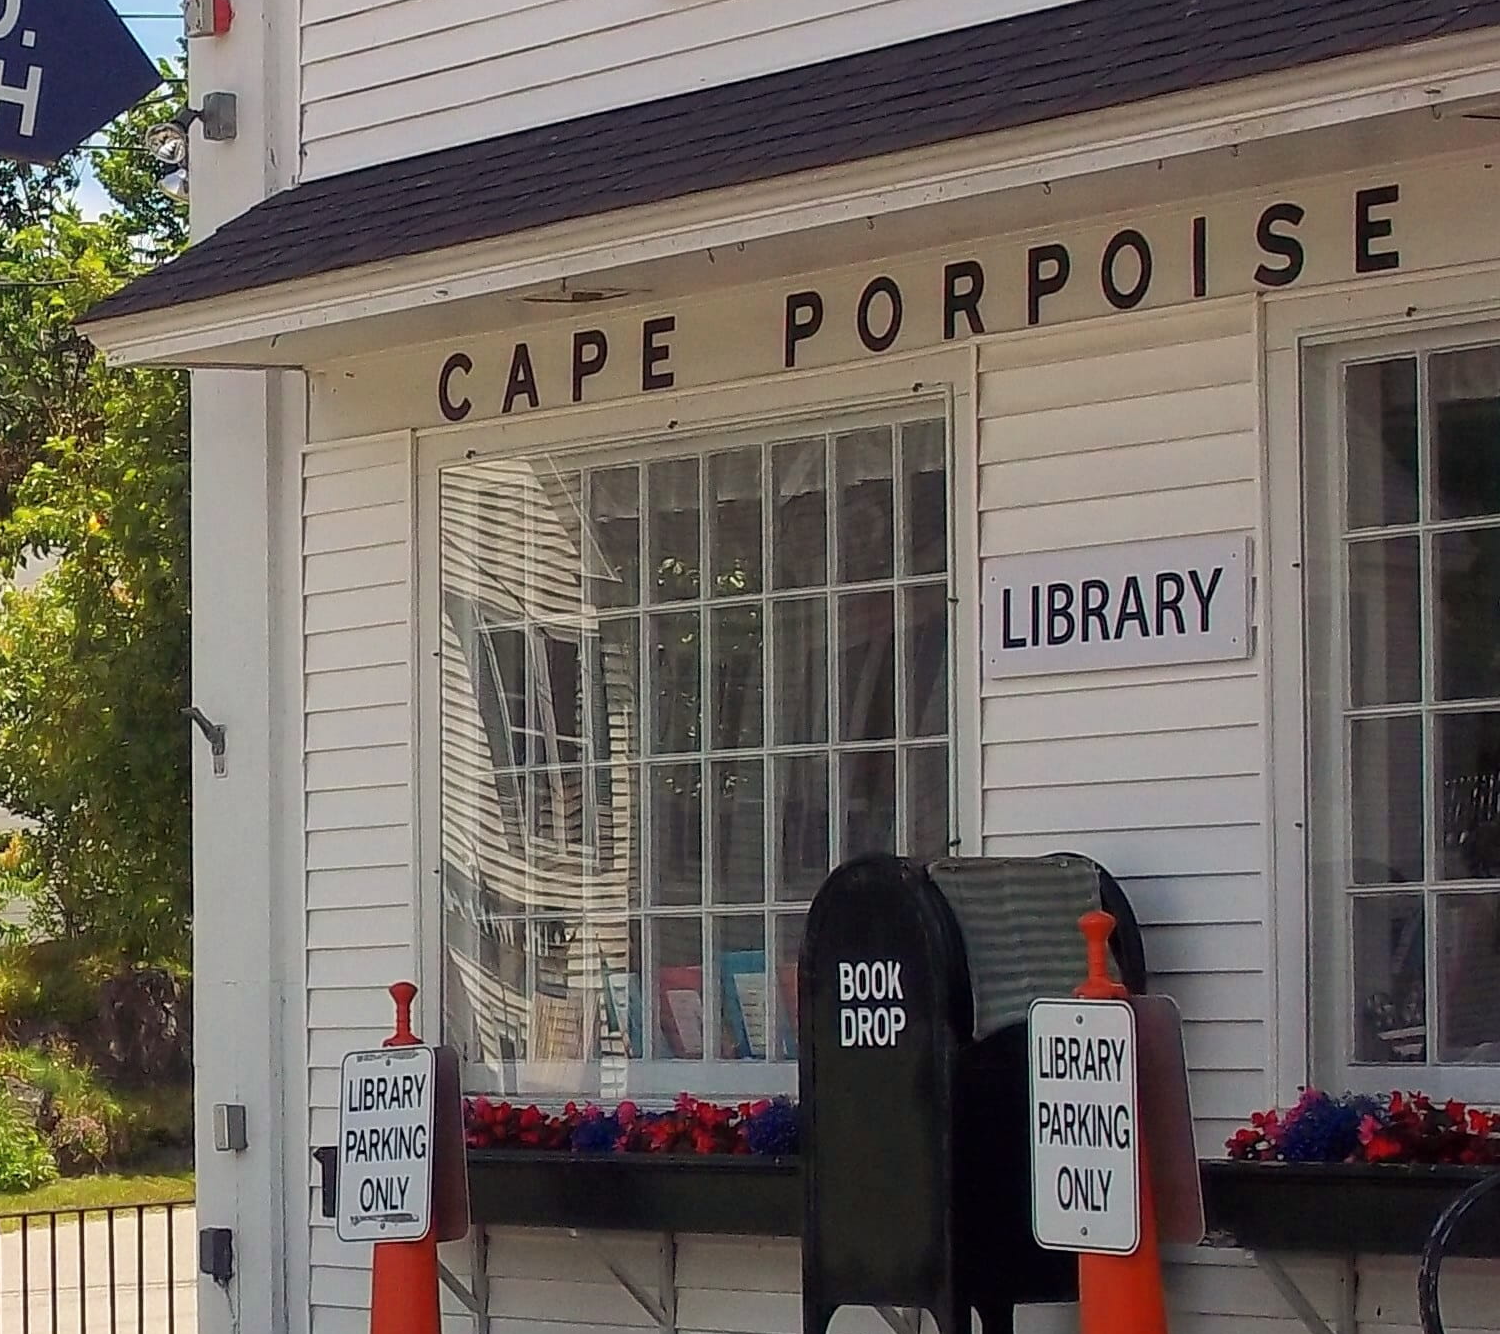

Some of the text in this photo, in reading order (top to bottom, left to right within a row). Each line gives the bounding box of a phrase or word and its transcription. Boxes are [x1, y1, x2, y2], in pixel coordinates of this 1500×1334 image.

[437, 183, 1400, 423] CAPE PORPOISE
[1001, 566, 1224, 649] LIBRARY
[838, 960, 904, 1002] BOOK
[840, 1006, 907, 1048] DROP
[1037, 1036, 1126, 1083] LIBRARY
[348, 1073, 427, 1113] LIBRARY
[345, 1124, 427, 1164] PARKING
[1038, 1102, 1131, 1150] PARKING
[359, 1175, 410, 1213] ONLY
[1056, 1165, 1114, 1212] ONLY
